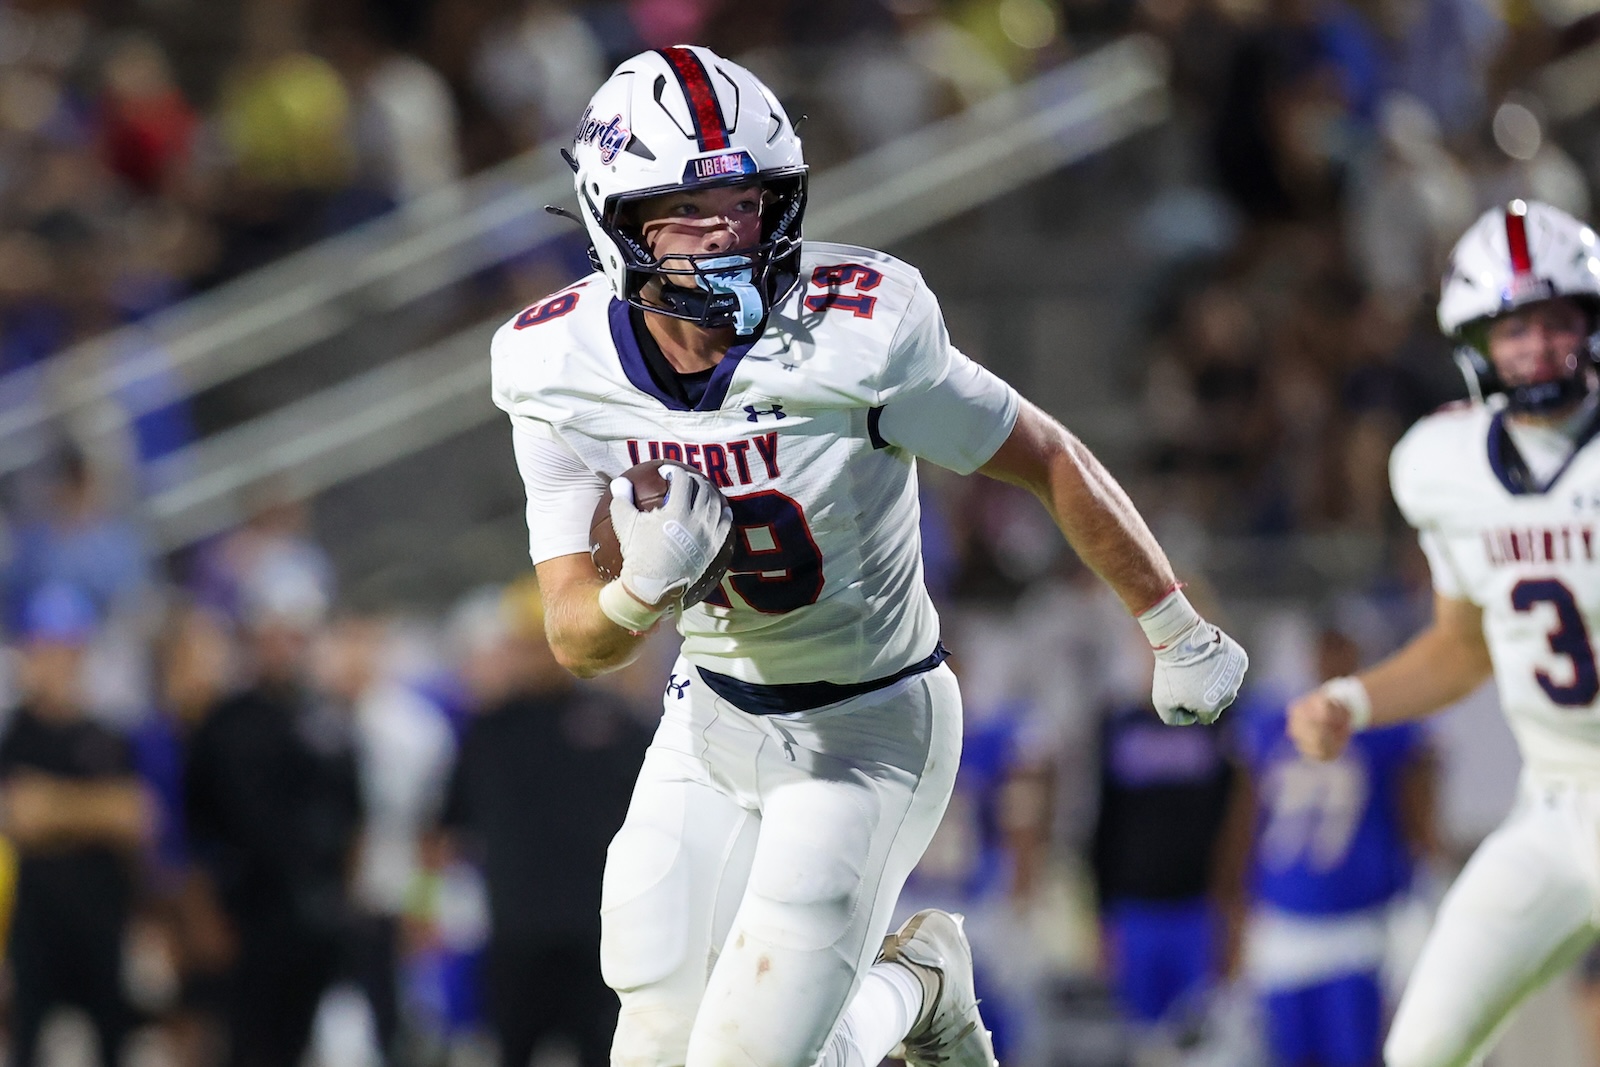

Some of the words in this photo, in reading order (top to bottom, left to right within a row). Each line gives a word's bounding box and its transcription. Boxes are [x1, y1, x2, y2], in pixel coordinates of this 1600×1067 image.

[694, 154, 743, 177] LIBERTY
[771, 201, 800, 240] Riddell
[617, 229, 652, 263] ddell
[513, 281, 591, 330] 9
[803, 263, 884, 319] 19
[701, 489, 825, 614] 9
[1511, 578, 1600, 706] 3
